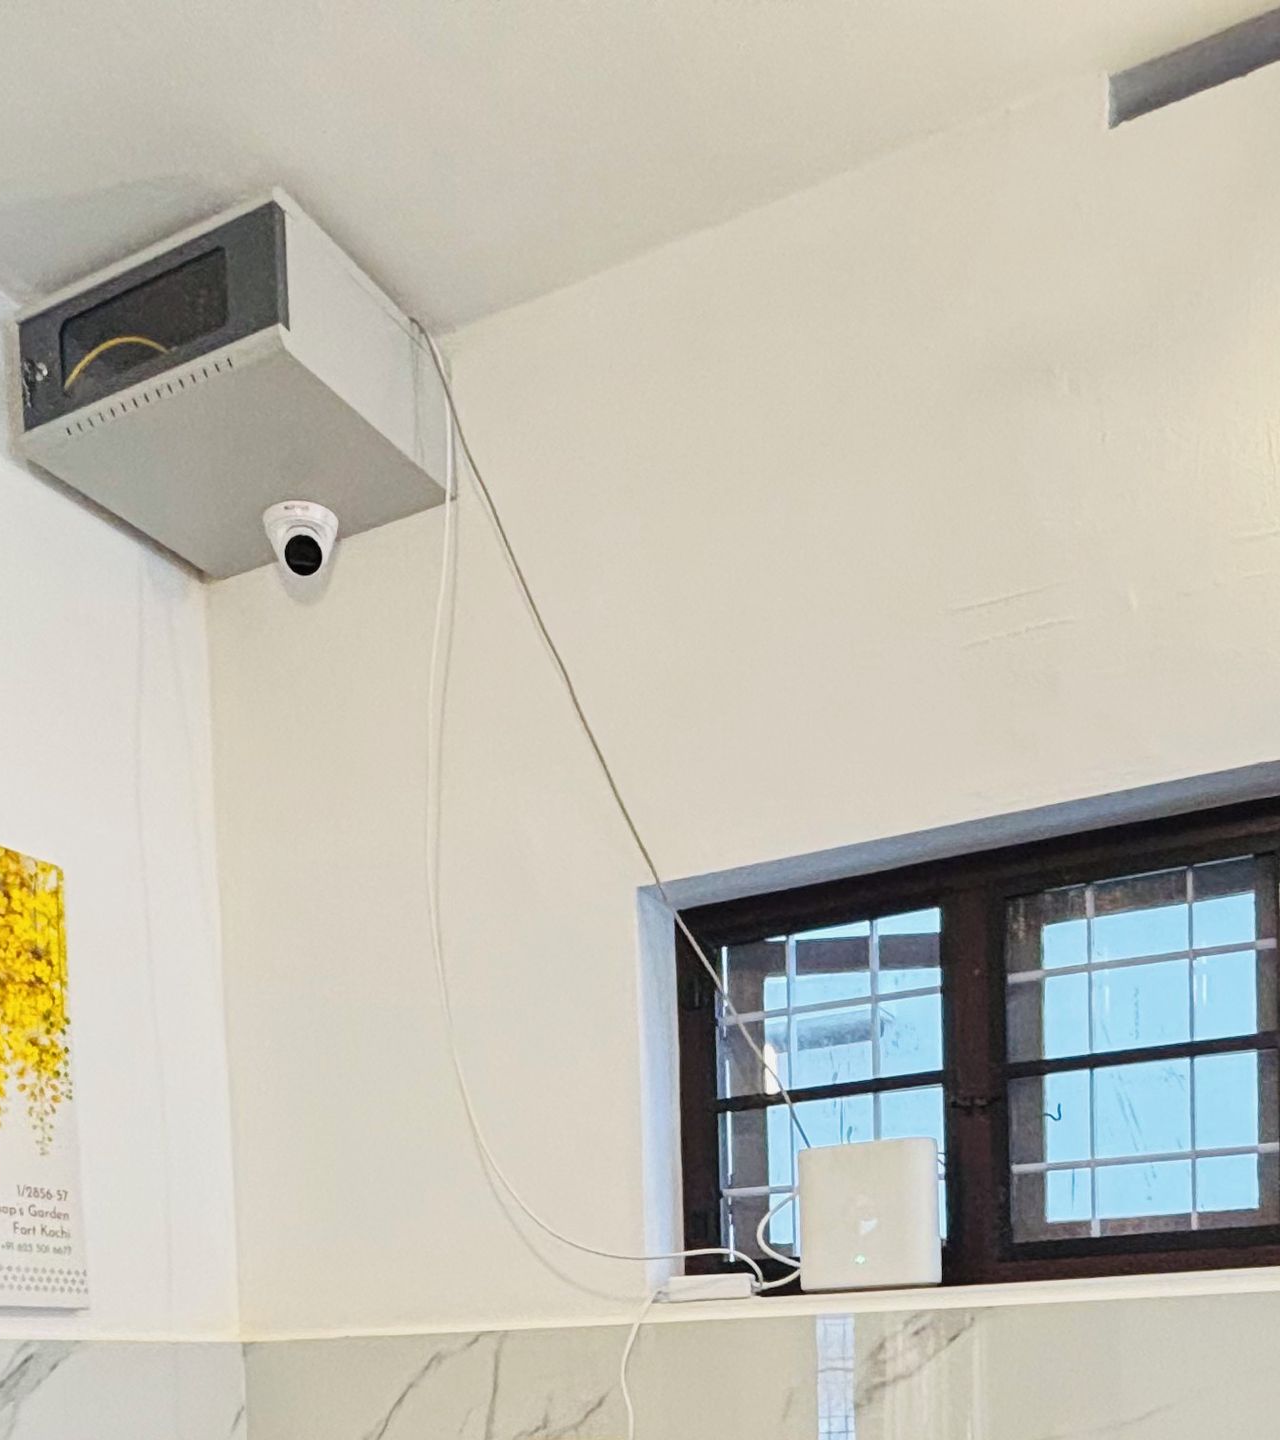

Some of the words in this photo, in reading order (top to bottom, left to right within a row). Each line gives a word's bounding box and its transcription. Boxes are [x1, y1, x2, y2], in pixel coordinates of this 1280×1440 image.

[28, 1204, 70, 1220] Garden
[12, 1221, 36, 1236] Fort
[40, 1224, 71, 1239] Kochi
